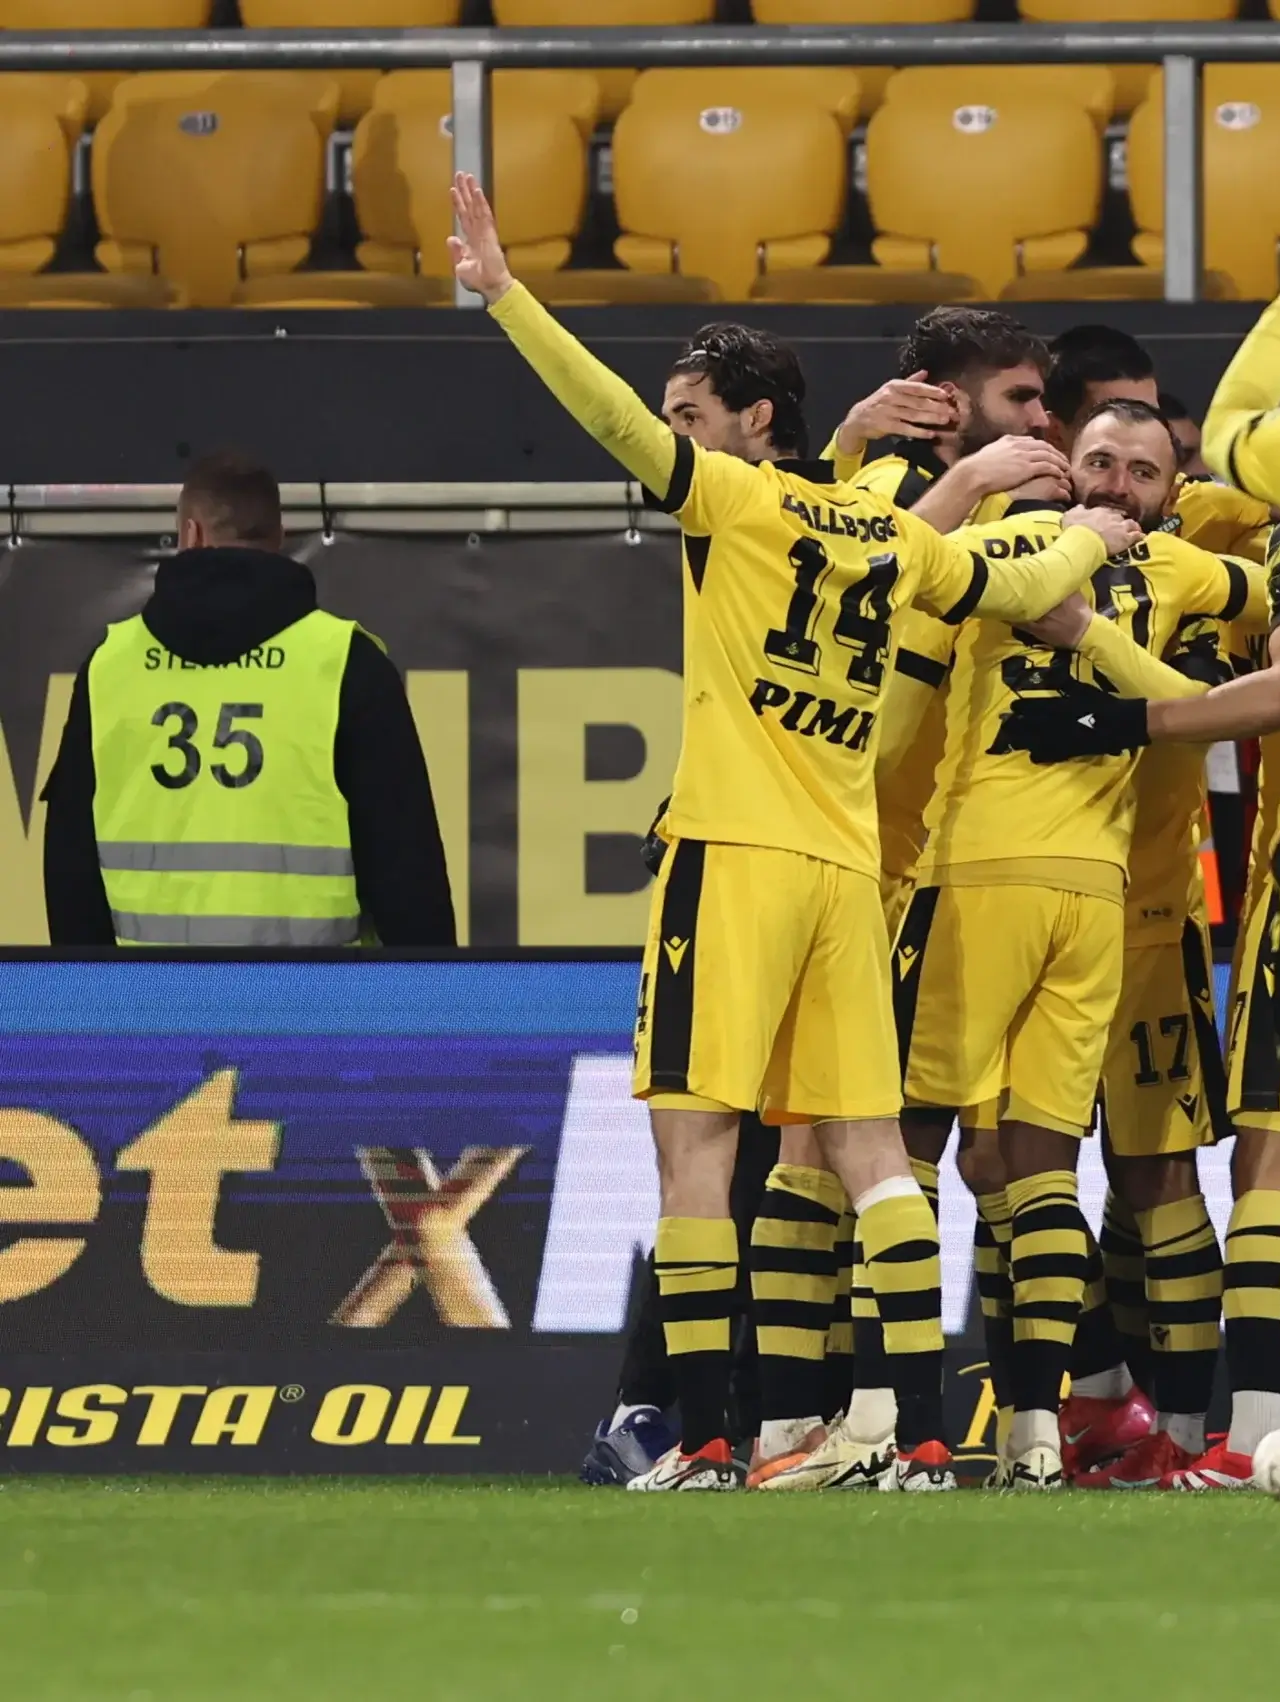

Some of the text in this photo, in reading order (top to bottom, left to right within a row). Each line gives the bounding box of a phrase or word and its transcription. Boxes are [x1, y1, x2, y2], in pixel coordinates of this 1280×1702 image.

[764, 536, 898, 696] 14
[150, 701, 264, 790] 35
[1130, 1013, 1192, 1086] 17
[311, 1384, 481, 1446] OIL
